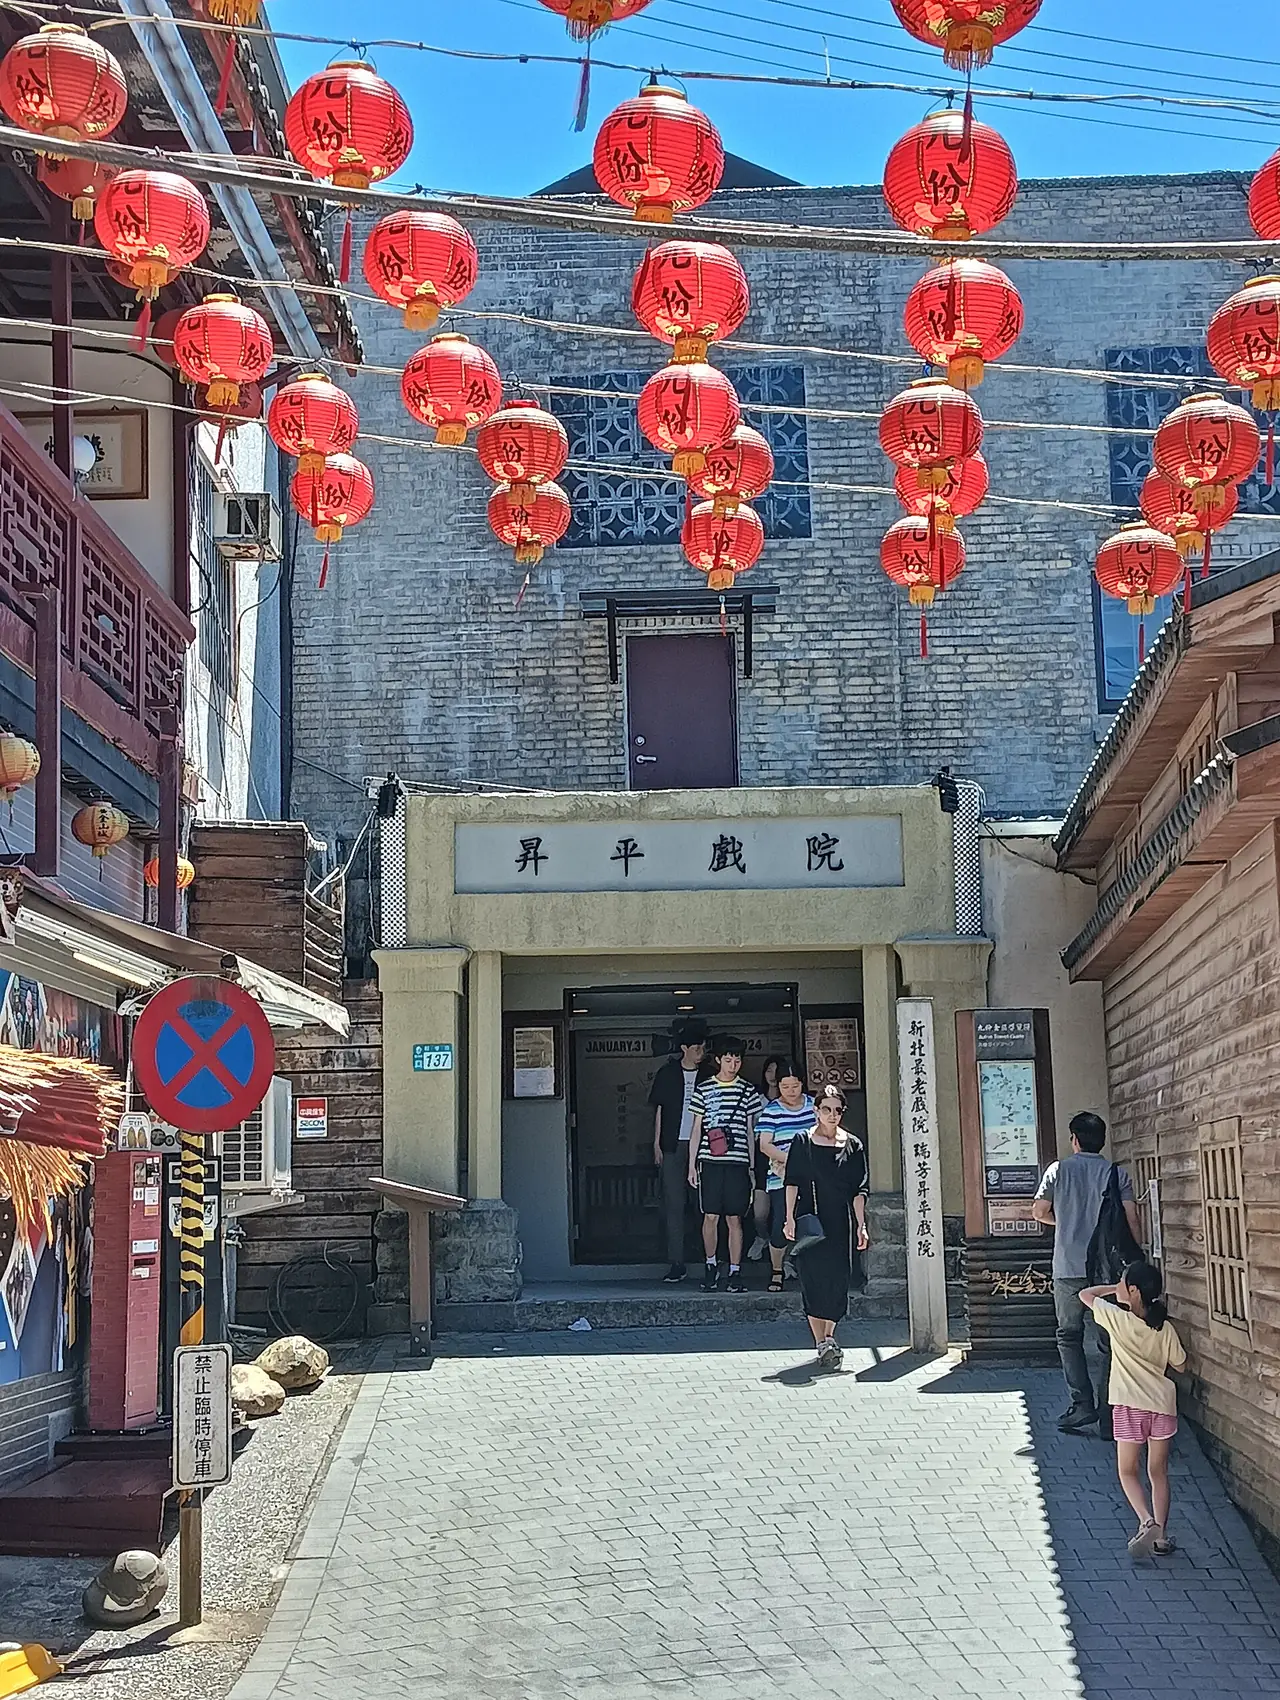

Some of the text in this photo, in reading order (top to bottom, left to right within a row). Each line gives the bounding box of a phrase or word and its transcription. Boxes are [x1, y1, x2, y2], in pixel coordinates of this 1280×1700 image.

[514, 832, 845, 877] 昇平戲院
[426, 1053, 450, 1068] 137
[194, 1355, 212, 1478] 禁止臨時停車
